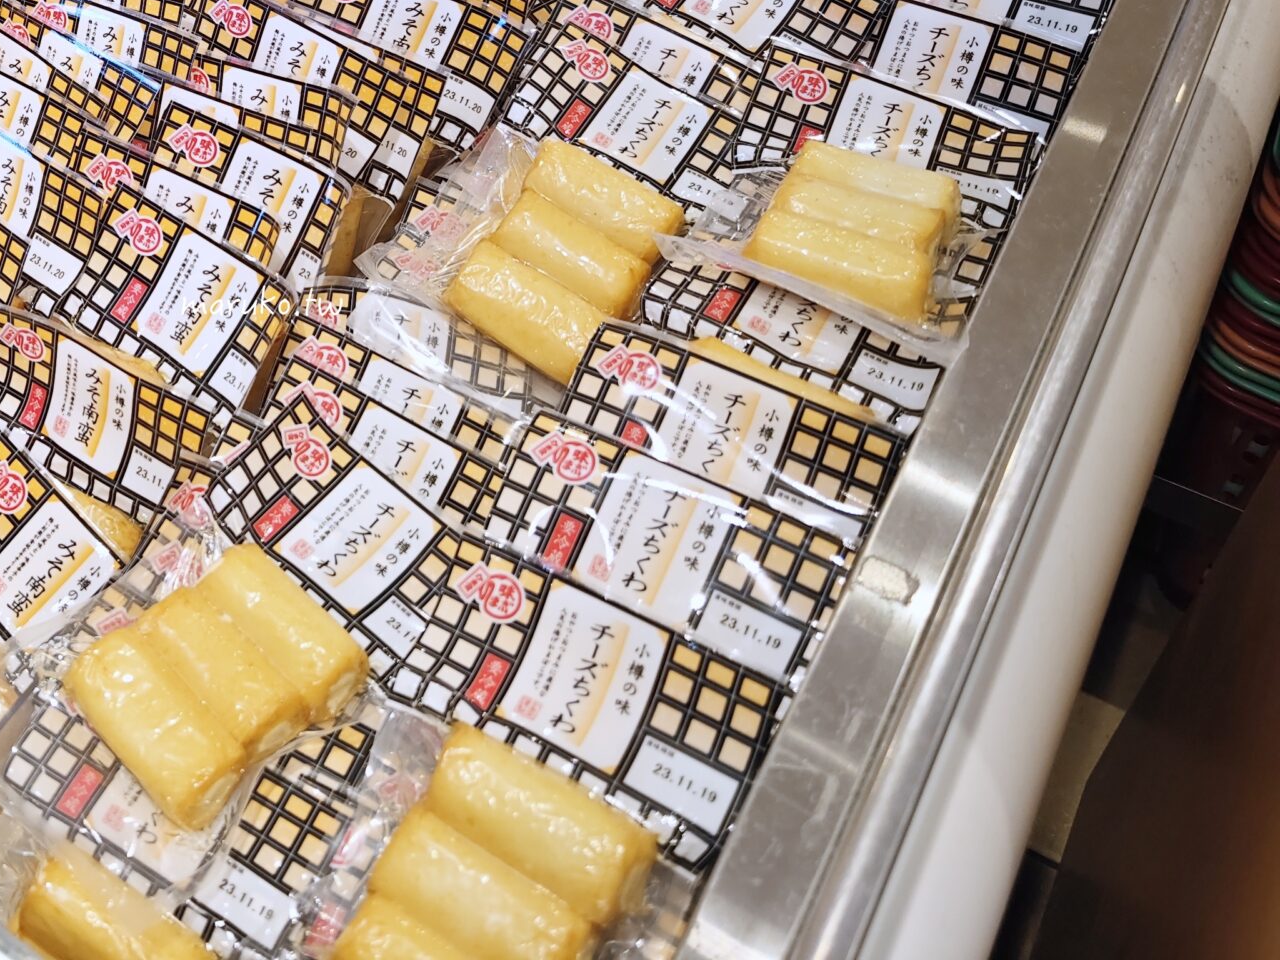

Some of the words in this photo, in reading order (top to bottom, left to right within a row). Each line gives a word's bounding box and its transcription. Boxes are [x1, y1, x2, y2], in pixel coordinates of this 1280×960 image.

[424, 13, 451, 59] 小樽の味
[1027, 16, 1078, 34] 23.11.19
[950, 36, 979, 90] 小樽の味
[17, 103, 32, 137] 小樽の
[443, 89, 482, 114] 23.11.20
[618, 99, 672, 159] チーズちくわ
[665, 114, 697, 157] 小樽の味
[908, 114, 931, 158] 小樽の味
[18, 172, 36, 220] 小樽の味
[282, 183, 310, 233] 小樽の味
[29, 254, 65, 279] 23.11.20
[867, 368, 923, 391] 23.11.19
[74, 369, 103, 447] みそ南蛮
[113, 384, 126, 431] 小樽の味
[747, 409, 780, 473] 小樽の味
[317, 503, 395, 577] チーズちくわ
[375, 528, 420, 577] 小樽の味
[622, 490, 688, 592] チーズちくわ
[683, 506, 722, 573] 小樽の味
[7, 539, 76, 617] みそ南蛮
[719, 612, 781, 649] 23.11.19
[550, 623, 615, 734] チーズちくわ
[615, 644, 650, 716] 小樽の味
[652, 762, 718, 803] 23.11.19
[219, 878, 274, 921] 23.11.19
